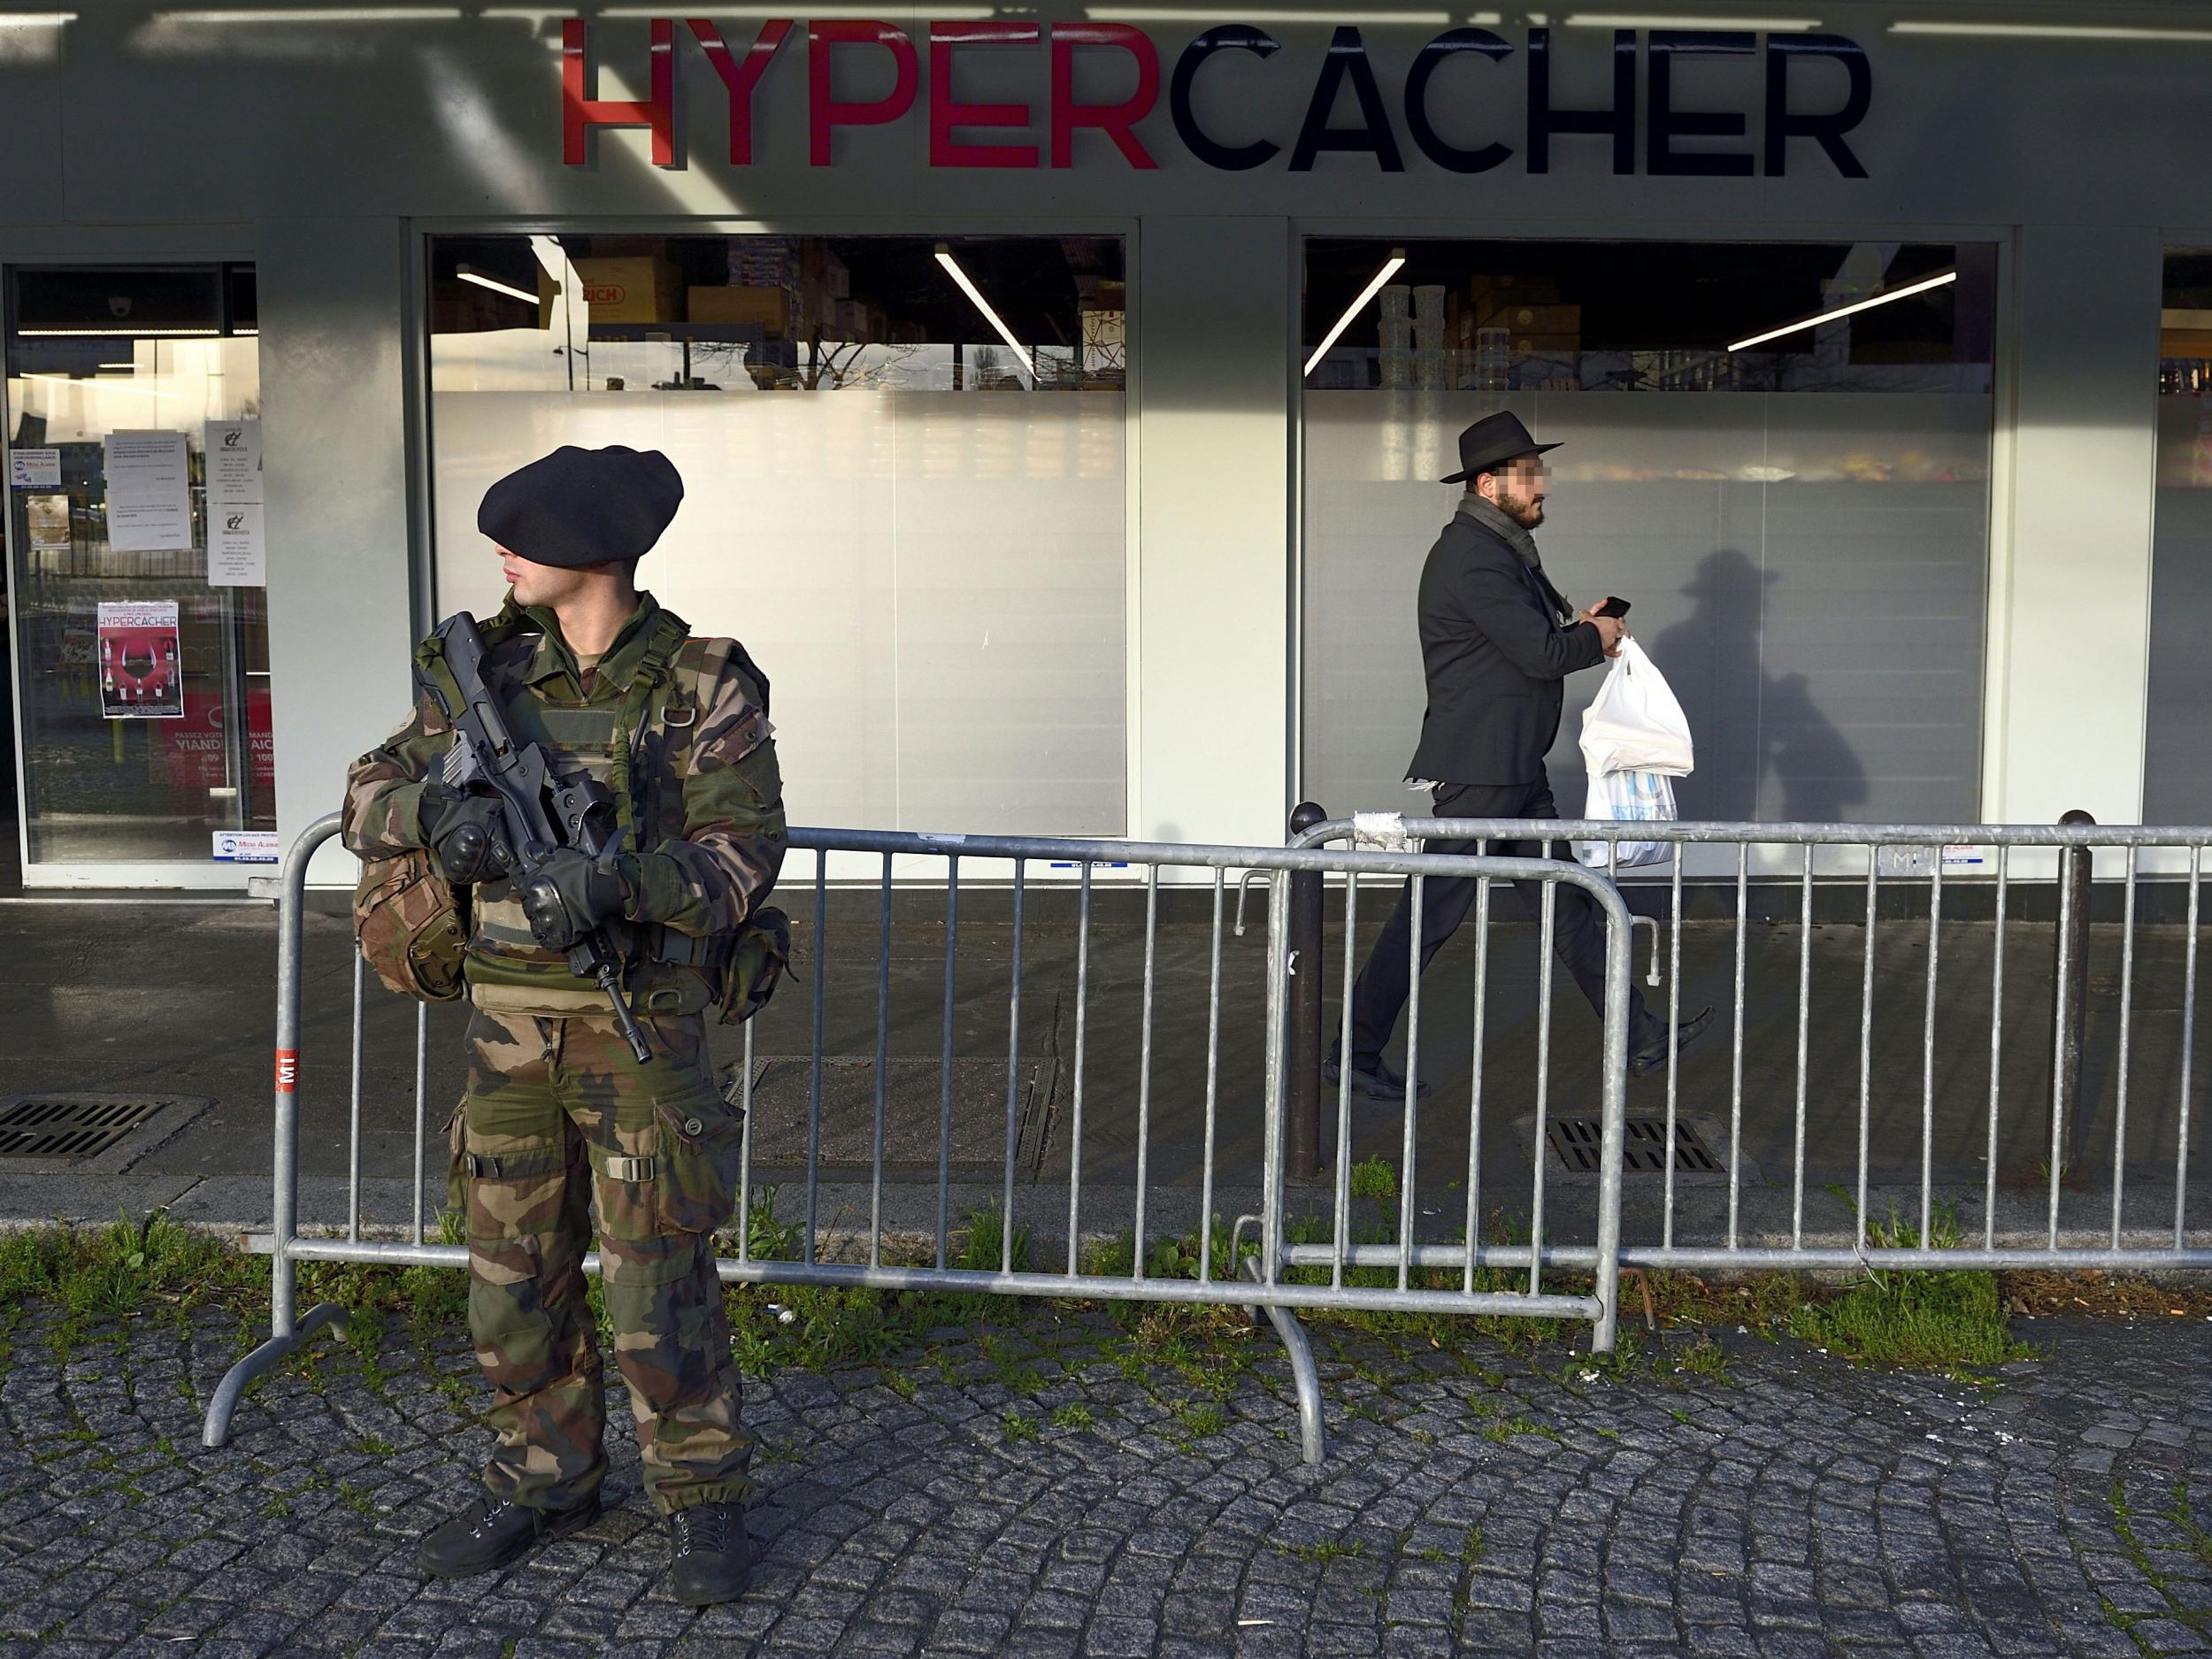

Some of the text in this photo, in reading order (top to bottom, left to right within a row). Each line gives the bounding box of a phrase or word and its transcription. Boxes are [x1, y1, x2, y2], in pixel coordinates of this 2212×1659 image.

[563, 19, 1870, 178] HYPERCACHER
[98, 616, 177, 626] HYPERCACHER
[176, 739, 224, 750] VIAND
